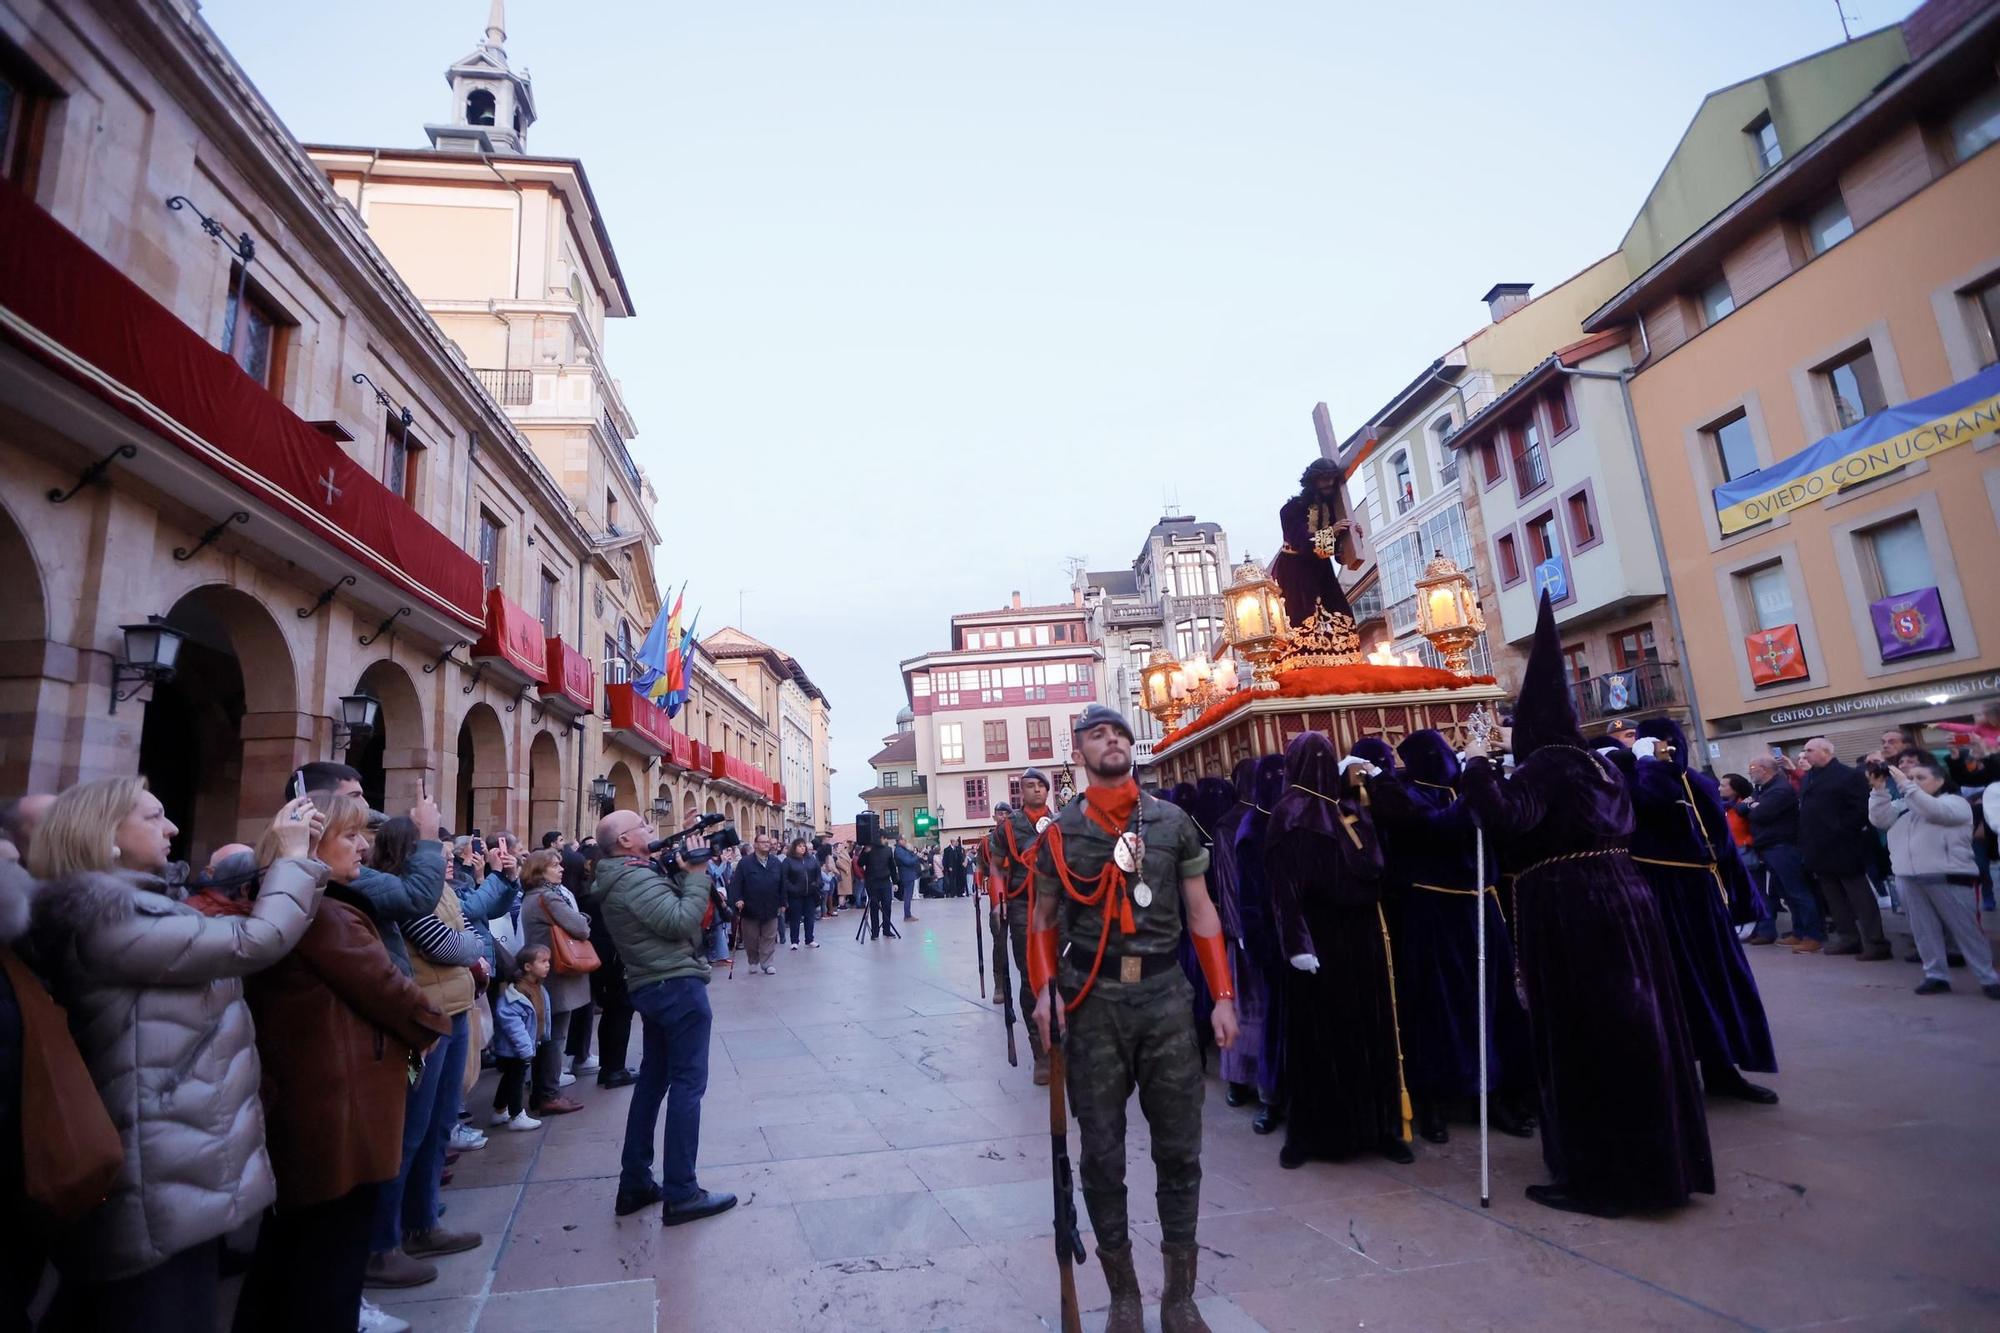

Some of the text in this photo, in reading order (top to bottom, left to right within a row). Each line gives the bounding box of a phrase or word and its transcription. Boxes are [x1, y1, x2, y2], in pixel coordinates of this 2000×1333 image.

[1744, 476, 1824, 520] OVIEDO
[1831, 448, 1889, 484] CON
[1770, 707, 1814, 723] CENTRO
[1816, 704, 1832, 716] DE
